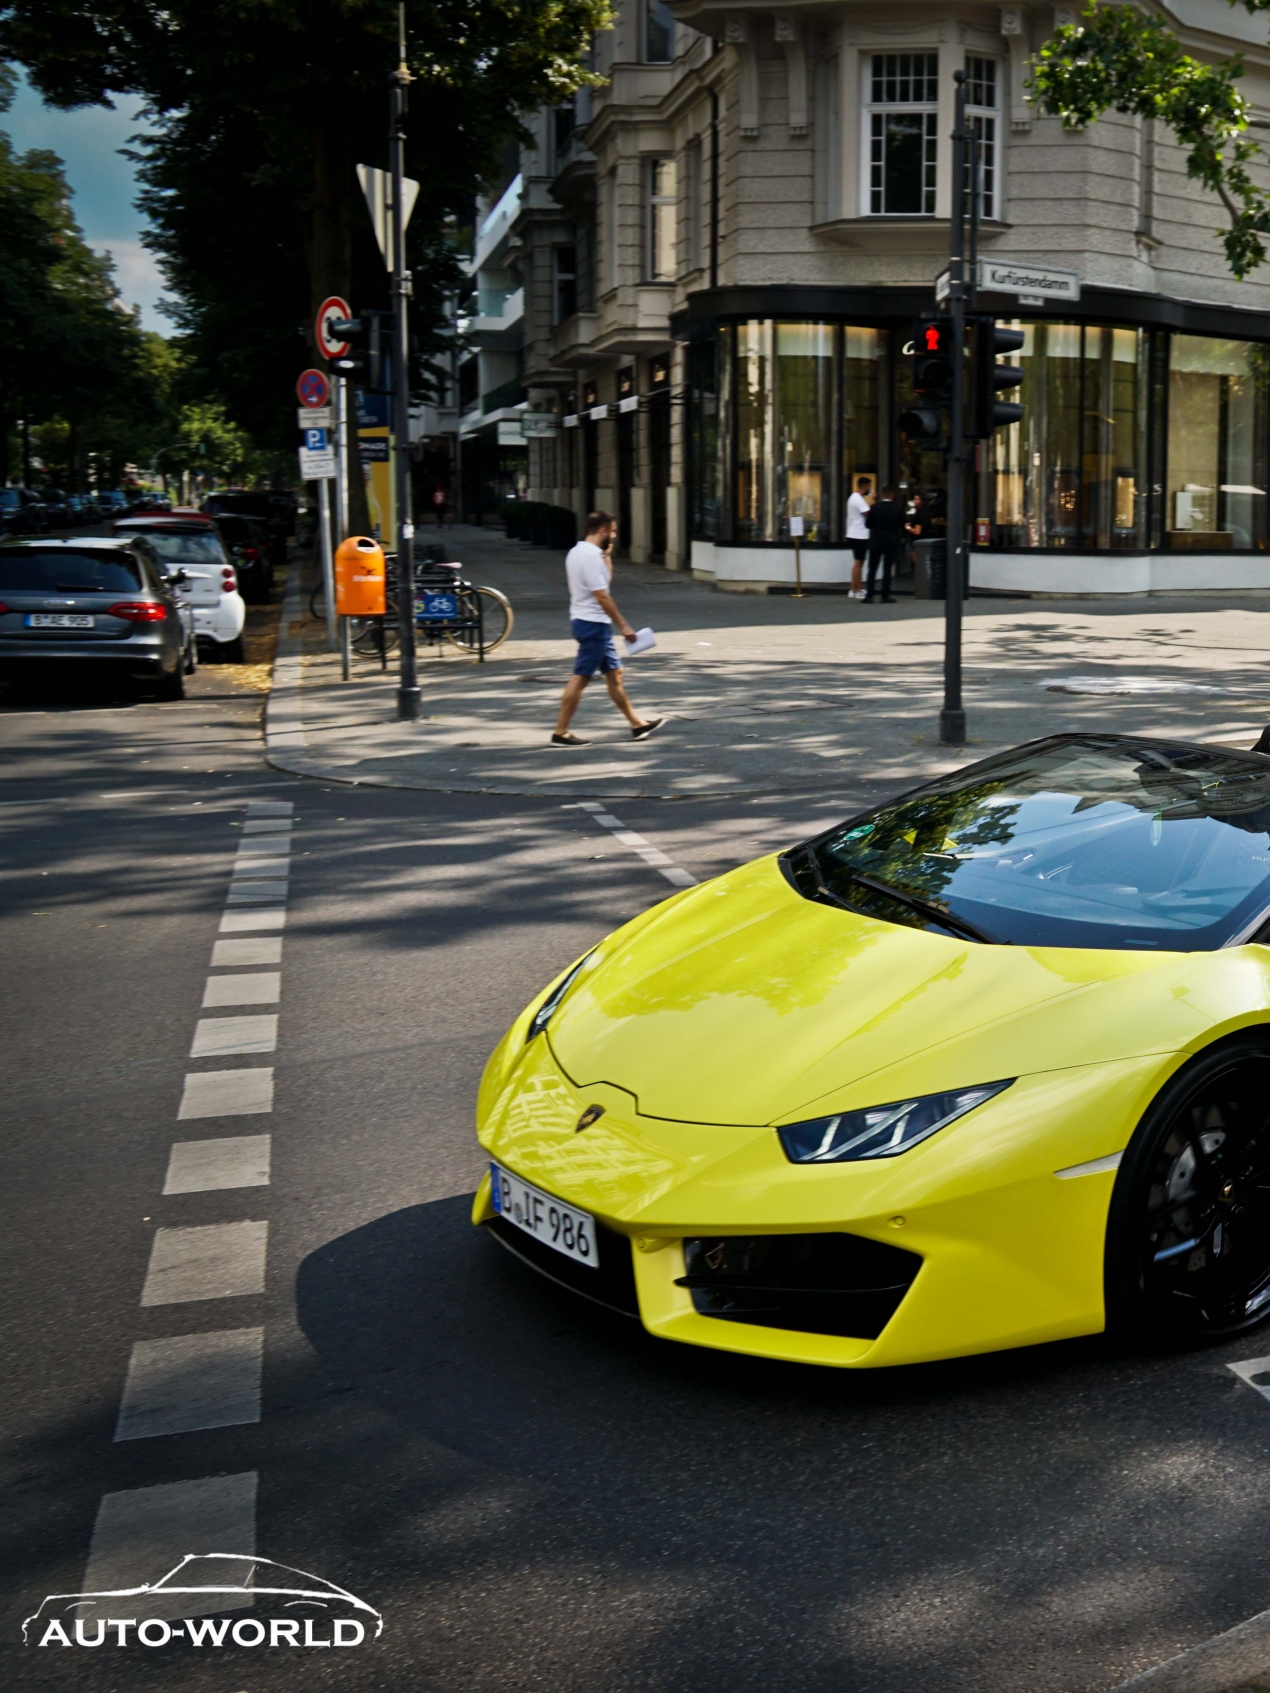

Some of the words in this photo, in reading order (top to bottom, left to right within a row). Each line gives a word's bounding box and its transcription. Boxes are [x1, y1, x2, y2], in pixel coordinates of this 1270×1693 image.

[990, 268, 1070, 291] Kurfürstendamm
[501, 1176, 512, 1214] B
[549, 1206, 590, 1258] 986
